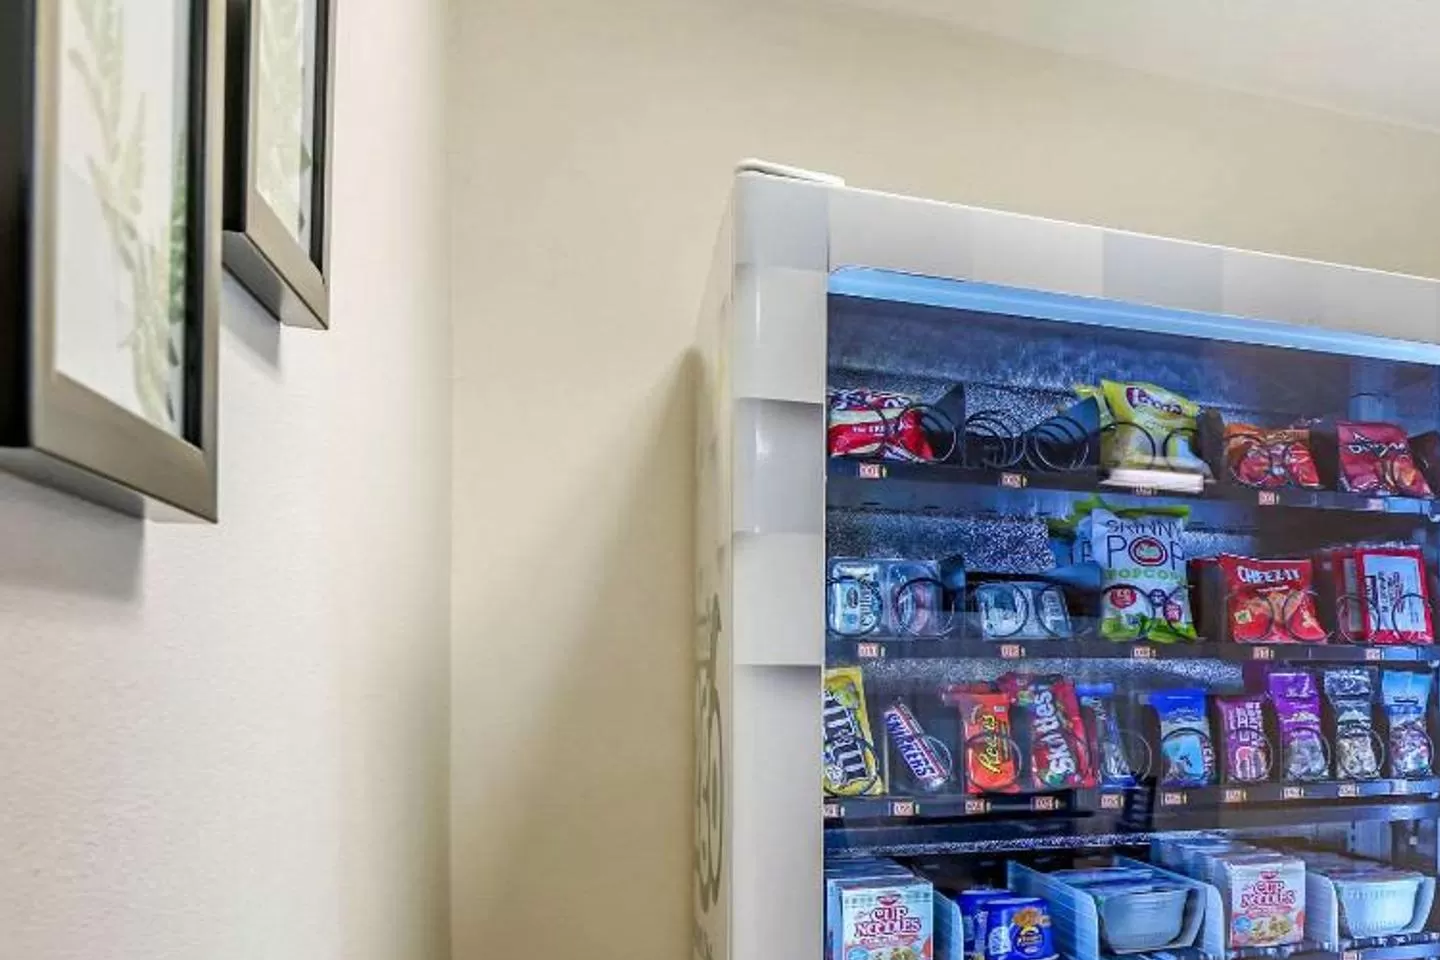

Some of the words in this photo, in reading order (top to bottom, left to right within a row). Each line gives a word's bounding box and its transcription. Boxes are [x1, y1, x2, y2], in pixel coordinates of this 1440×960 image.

[1106, 519, 1181, 538] SKINNY
[1107, 534, 1185, 570] POP
[886, 712, 936, 778] SNICKERS
[870, 905, 909, 922] CUP
[854, 917, 922, 937] NOODLES
